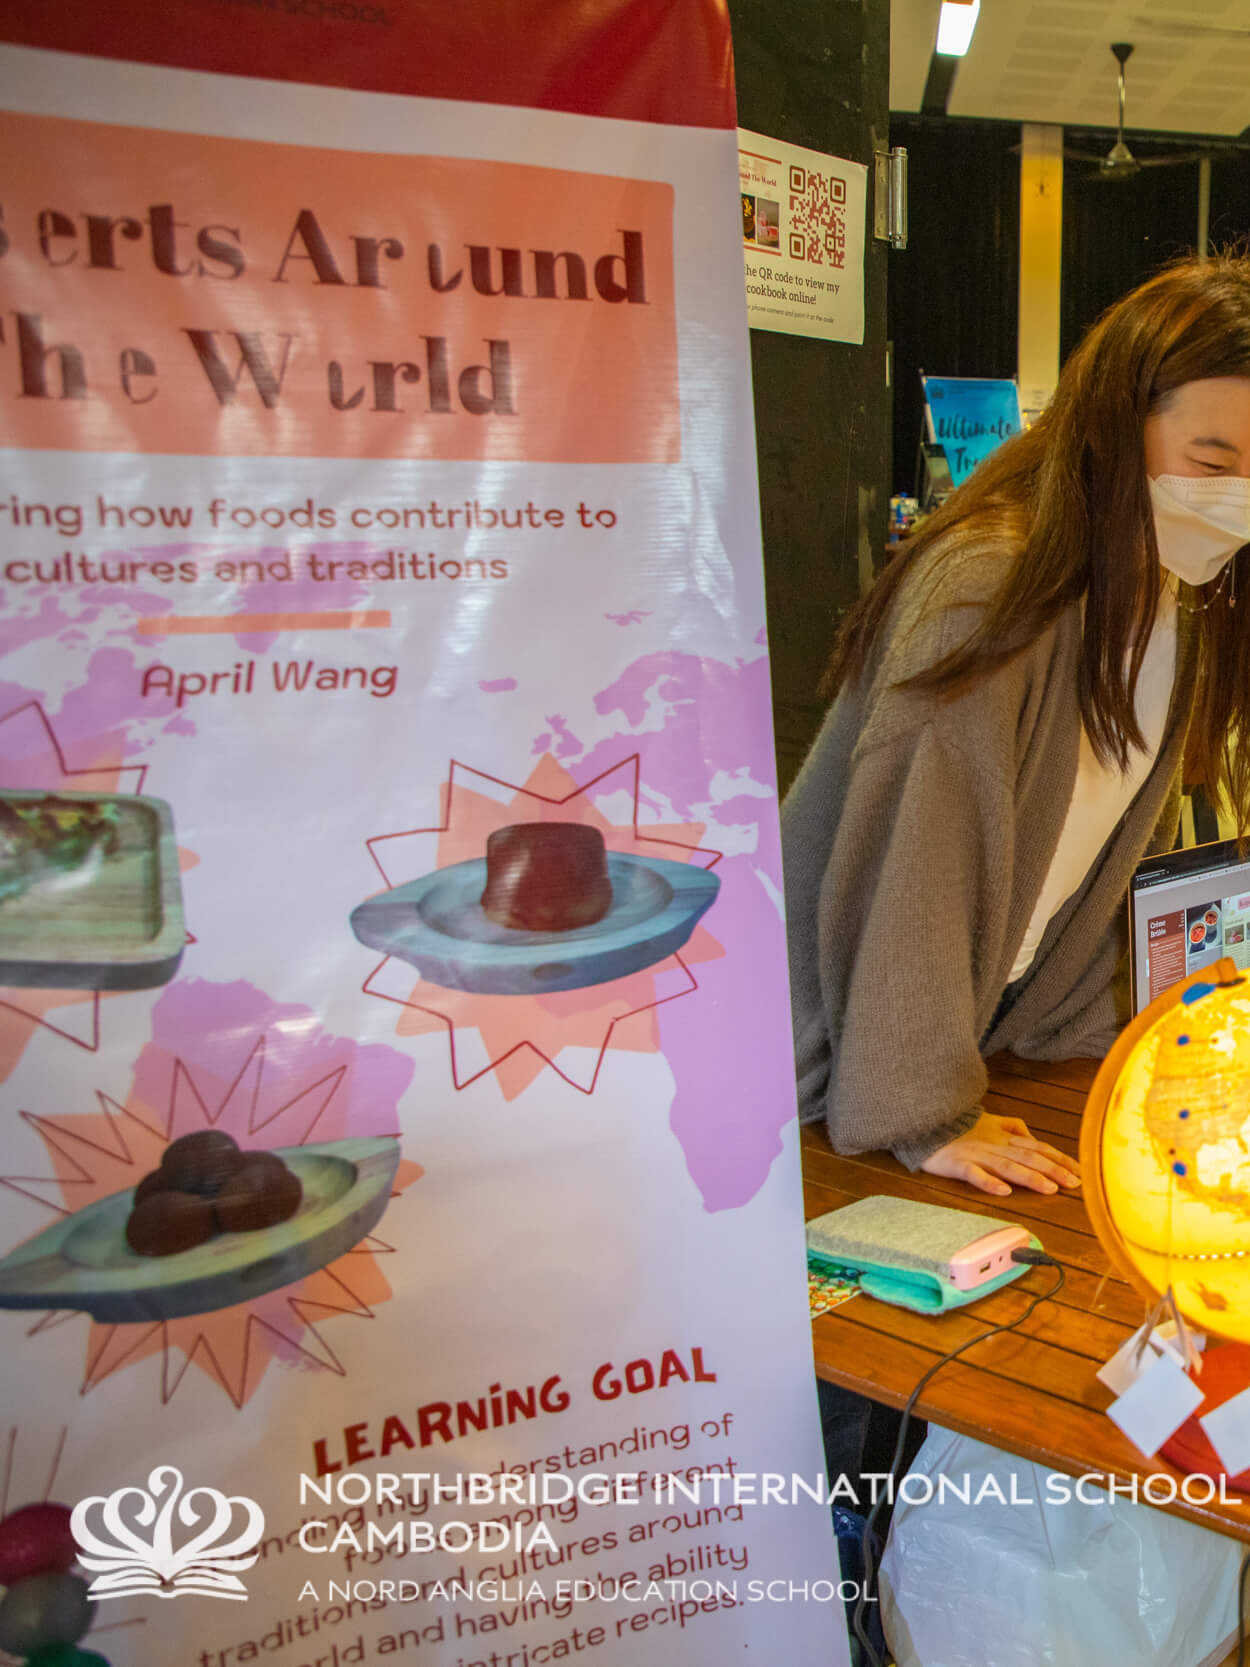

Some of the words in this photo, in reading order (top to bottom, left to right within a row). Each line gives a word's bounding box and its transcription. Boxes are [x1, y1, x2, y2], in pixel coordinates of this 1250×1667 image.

[0, 203, 245, 280] erts
[744, 264, 757, 277] he
[759, 266, 773, 281] QR
[775, 271, 794, 284] code
[795, 275, 804, 286] to
[805, 276, 825, 290] view
[826, 282, 841, 295] my
[746, 284, 788, 300] cookbook
[0, 309, 158, 405] he
[97, 494, 194, 529] how
[208, 497, 337, 529] foods
[351, 500, 565, 529] contribute
[576, 501, 617, 529] to
[4, 551, 199, 584] cultures
[215, 552, 293, 583] and
[306, 549, 508, 582] traditions
[141, 660, 255, 708] April
[272, 660, 398, 698] Wang
[592, 1347, 717, 1401] GOAL
[700, 1412, 735, 1438] of
[199, 1590, 388, 1667] traditions
[402, 1565, 467, 1605] and
[478, 1529, 619, 1582] cultures
[628, 1496, 744, 1543] around
[377, 1614, 445, 1655] and
[456, 1590, 574, 1638] having
[582, 1568, 638, 1601] the
[647, 1544, 749, 1582] ability
[615, 1588, 745, 1638] recipes.
